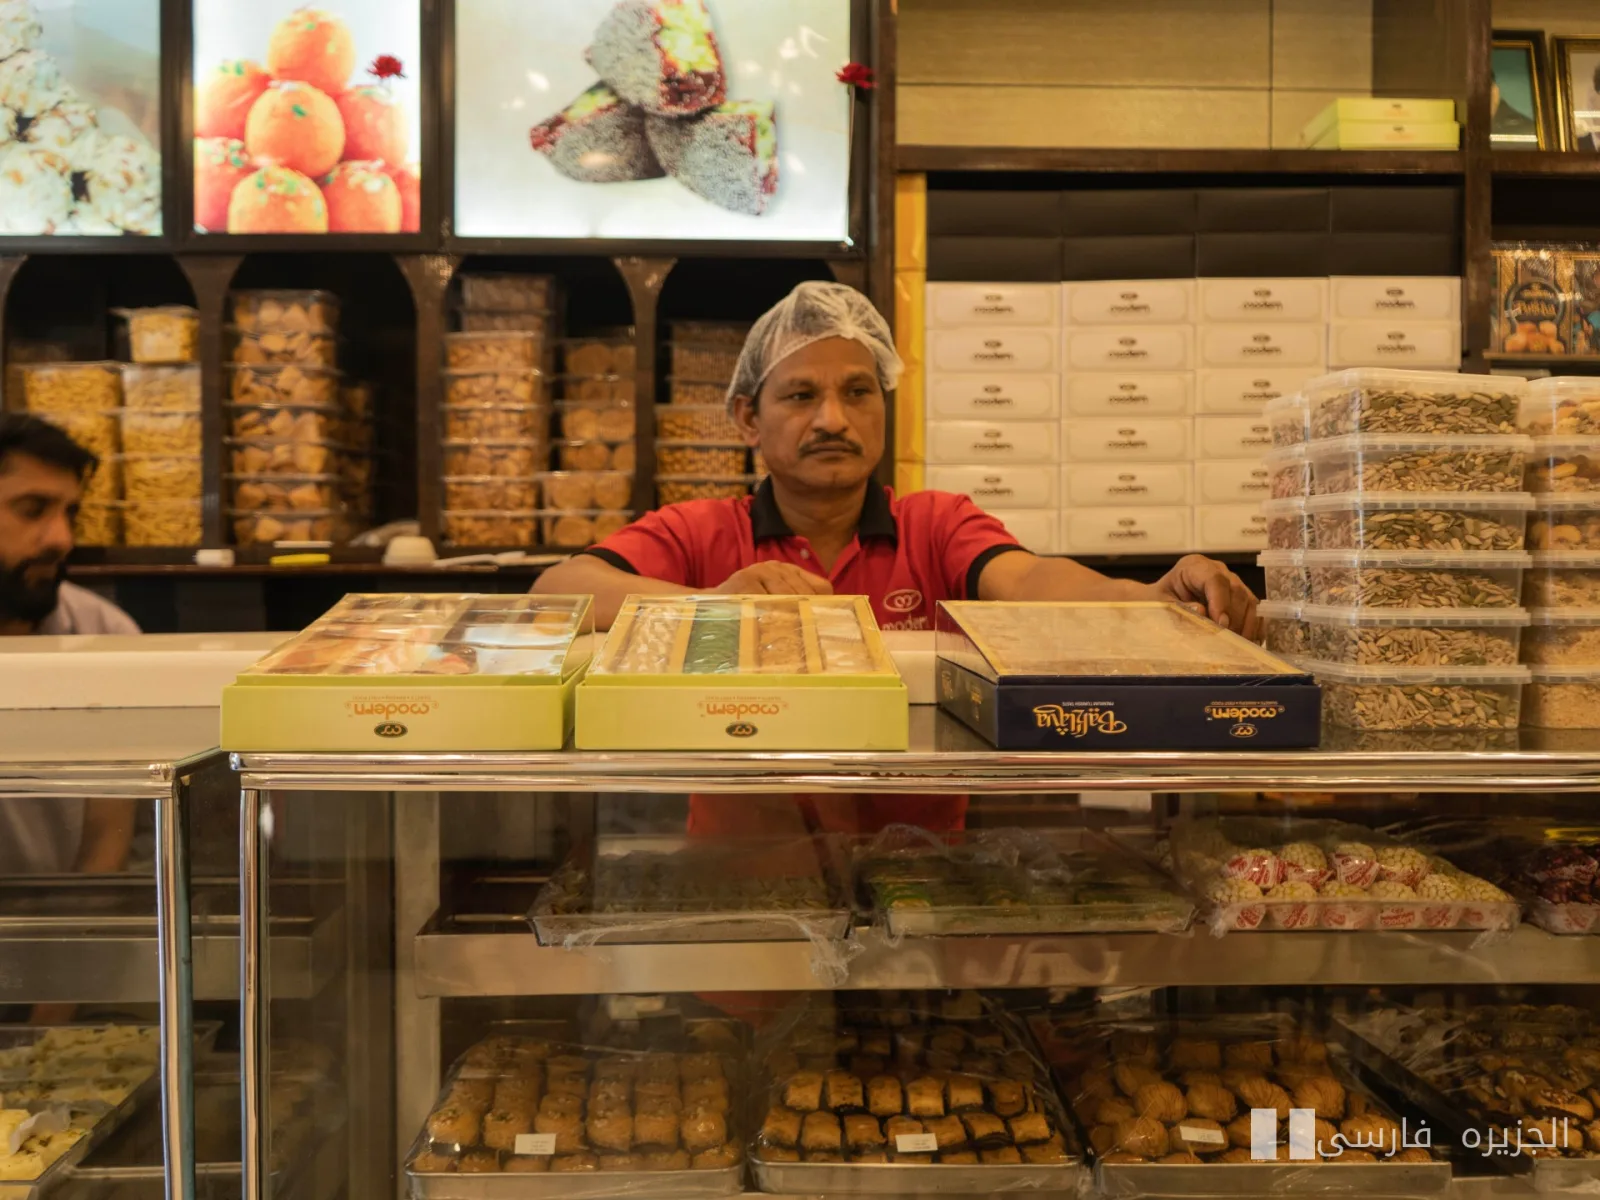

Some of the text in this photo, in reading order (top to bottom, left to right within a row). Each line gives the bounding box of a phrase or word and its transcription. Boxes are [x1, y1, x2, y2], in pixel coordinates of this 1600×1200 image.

[354, 703, 430, 721] modern
[706, 703, 780, 720] modern
[1212, 707, 1277, 722] modern
[1032, 704, 1128, 738] Baklava
